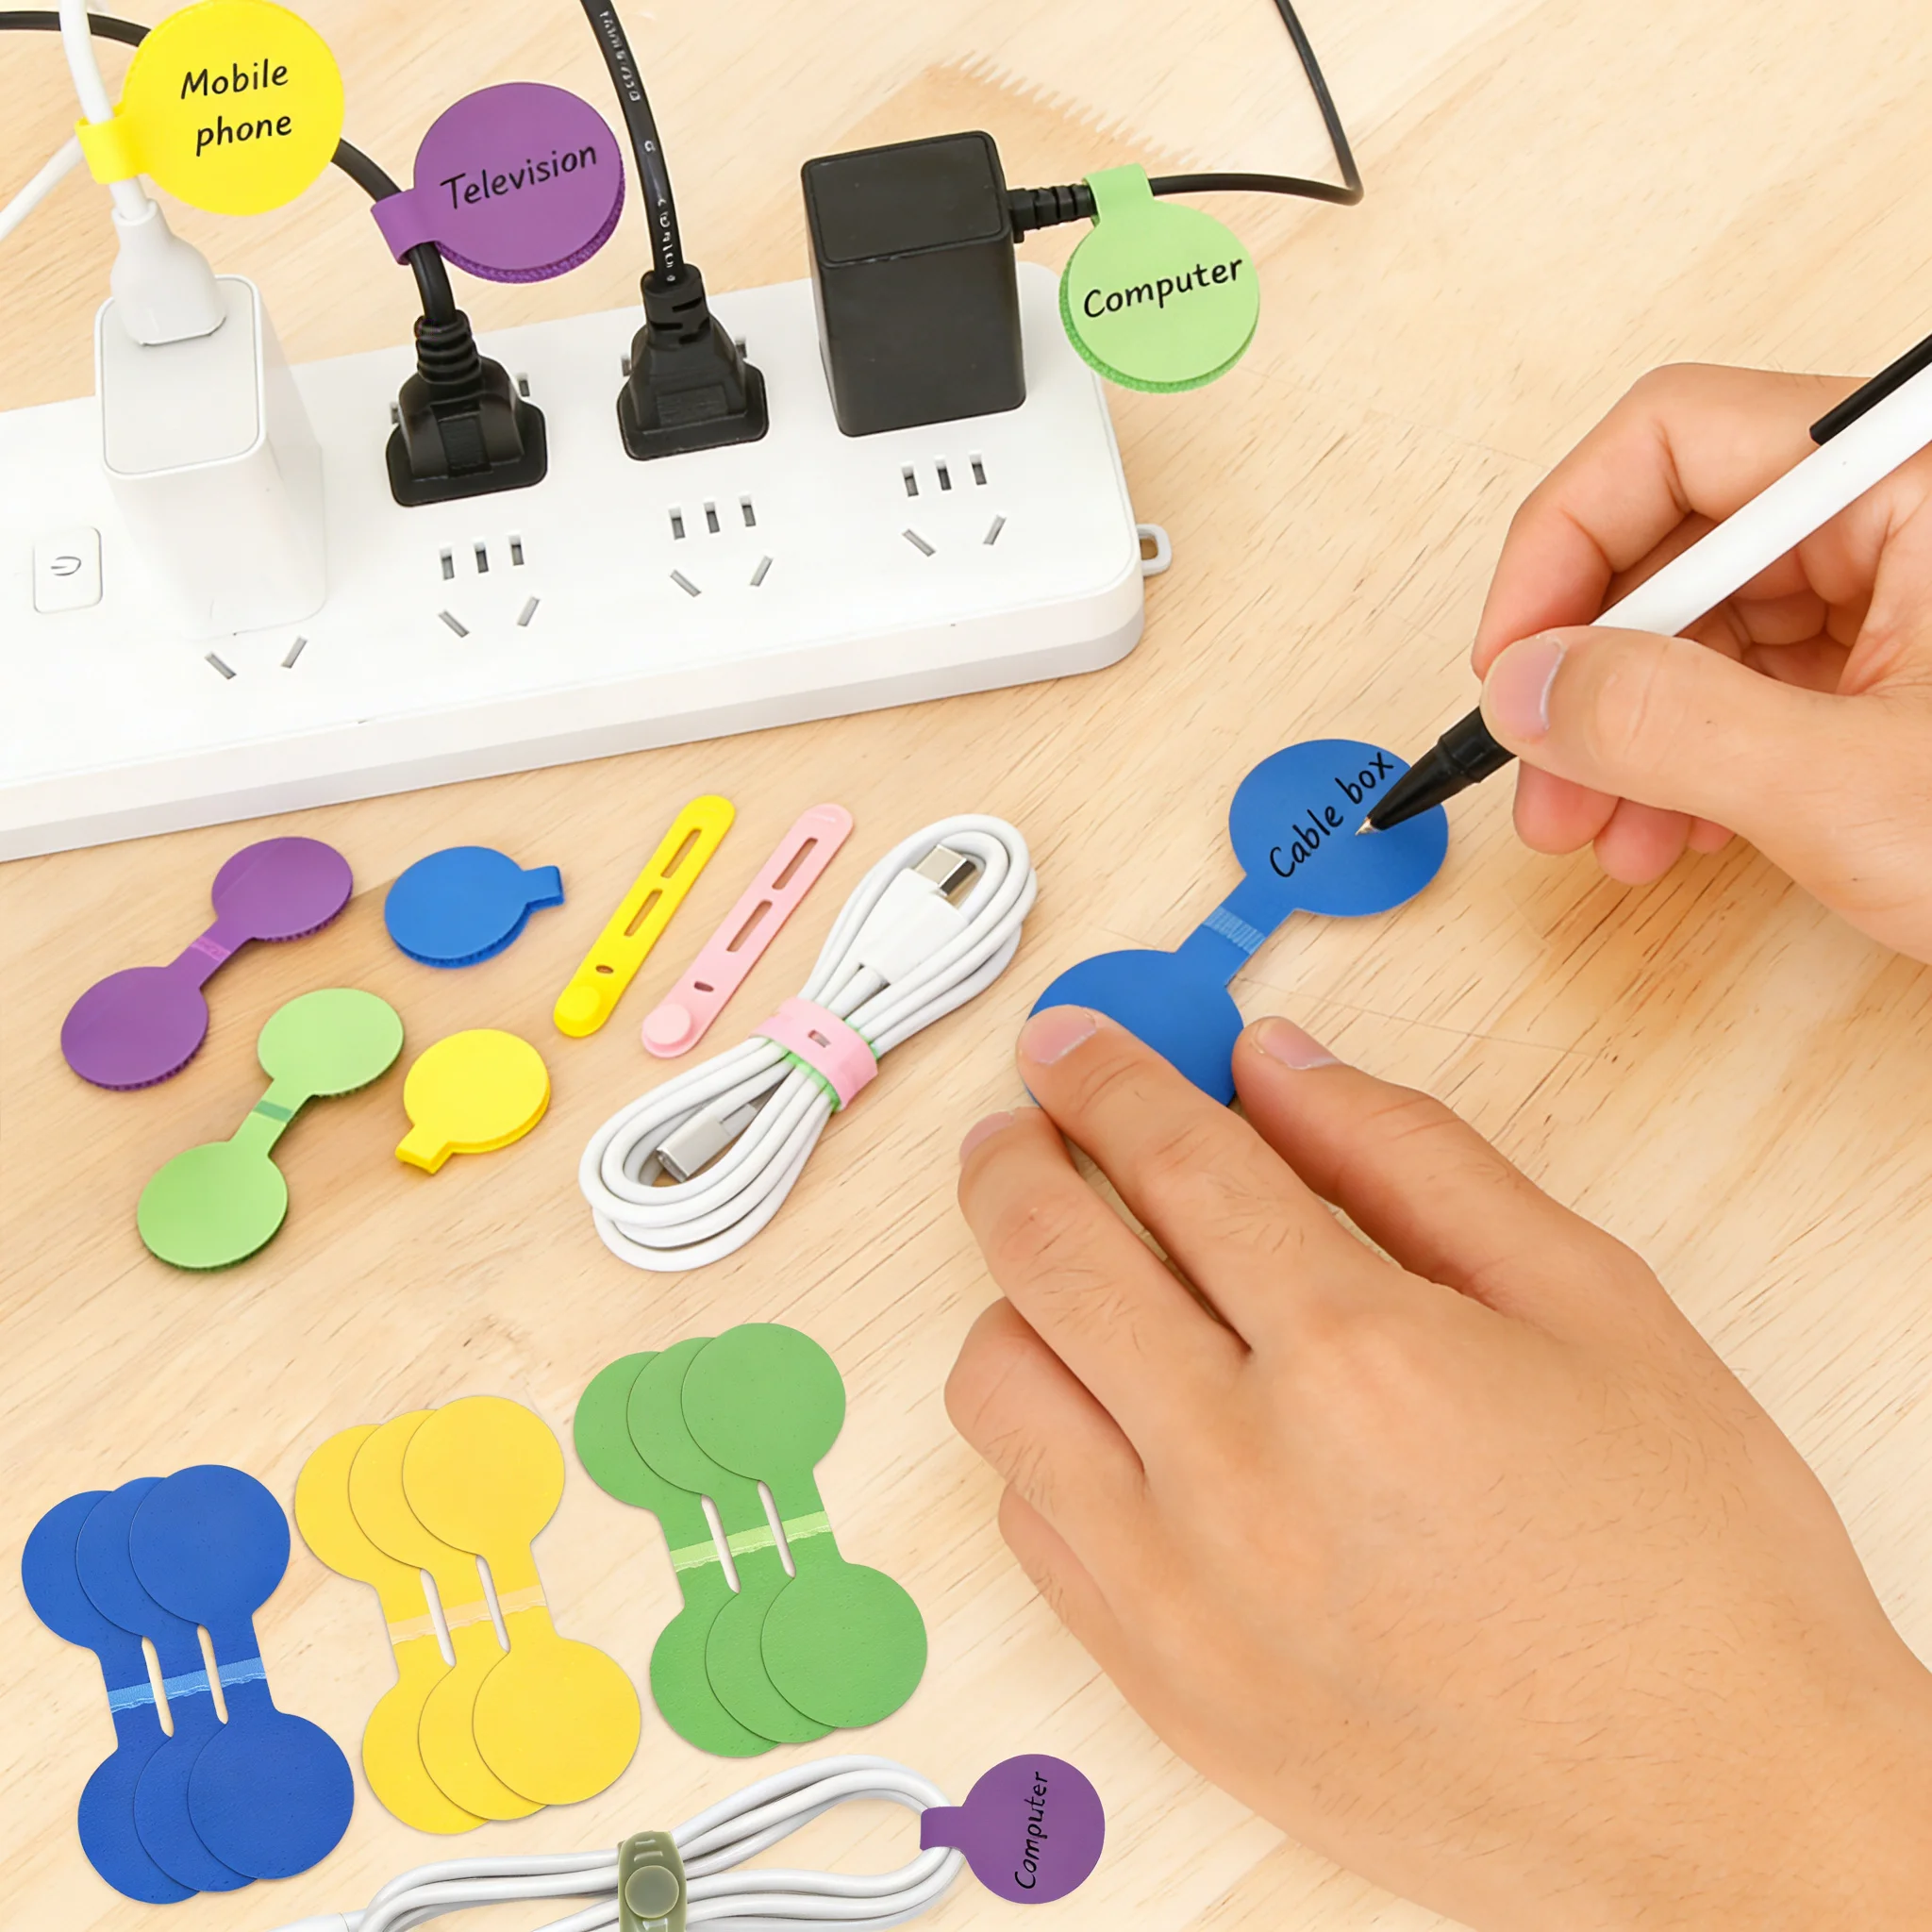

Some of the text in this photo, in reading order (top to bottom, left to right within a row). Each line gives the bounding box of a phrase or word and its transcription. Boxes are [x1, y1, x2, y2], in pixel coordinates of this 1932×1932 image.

[180, 58, 289, 100] Mobile
[195, 115, 292, 158] phone
[440, 146, 596, 209] Television
[1084, 259, 1242, 318] Computer
[1269, 751, 1394, 878] Cable box
[1014, 1771, 1048, 1890] Computer
